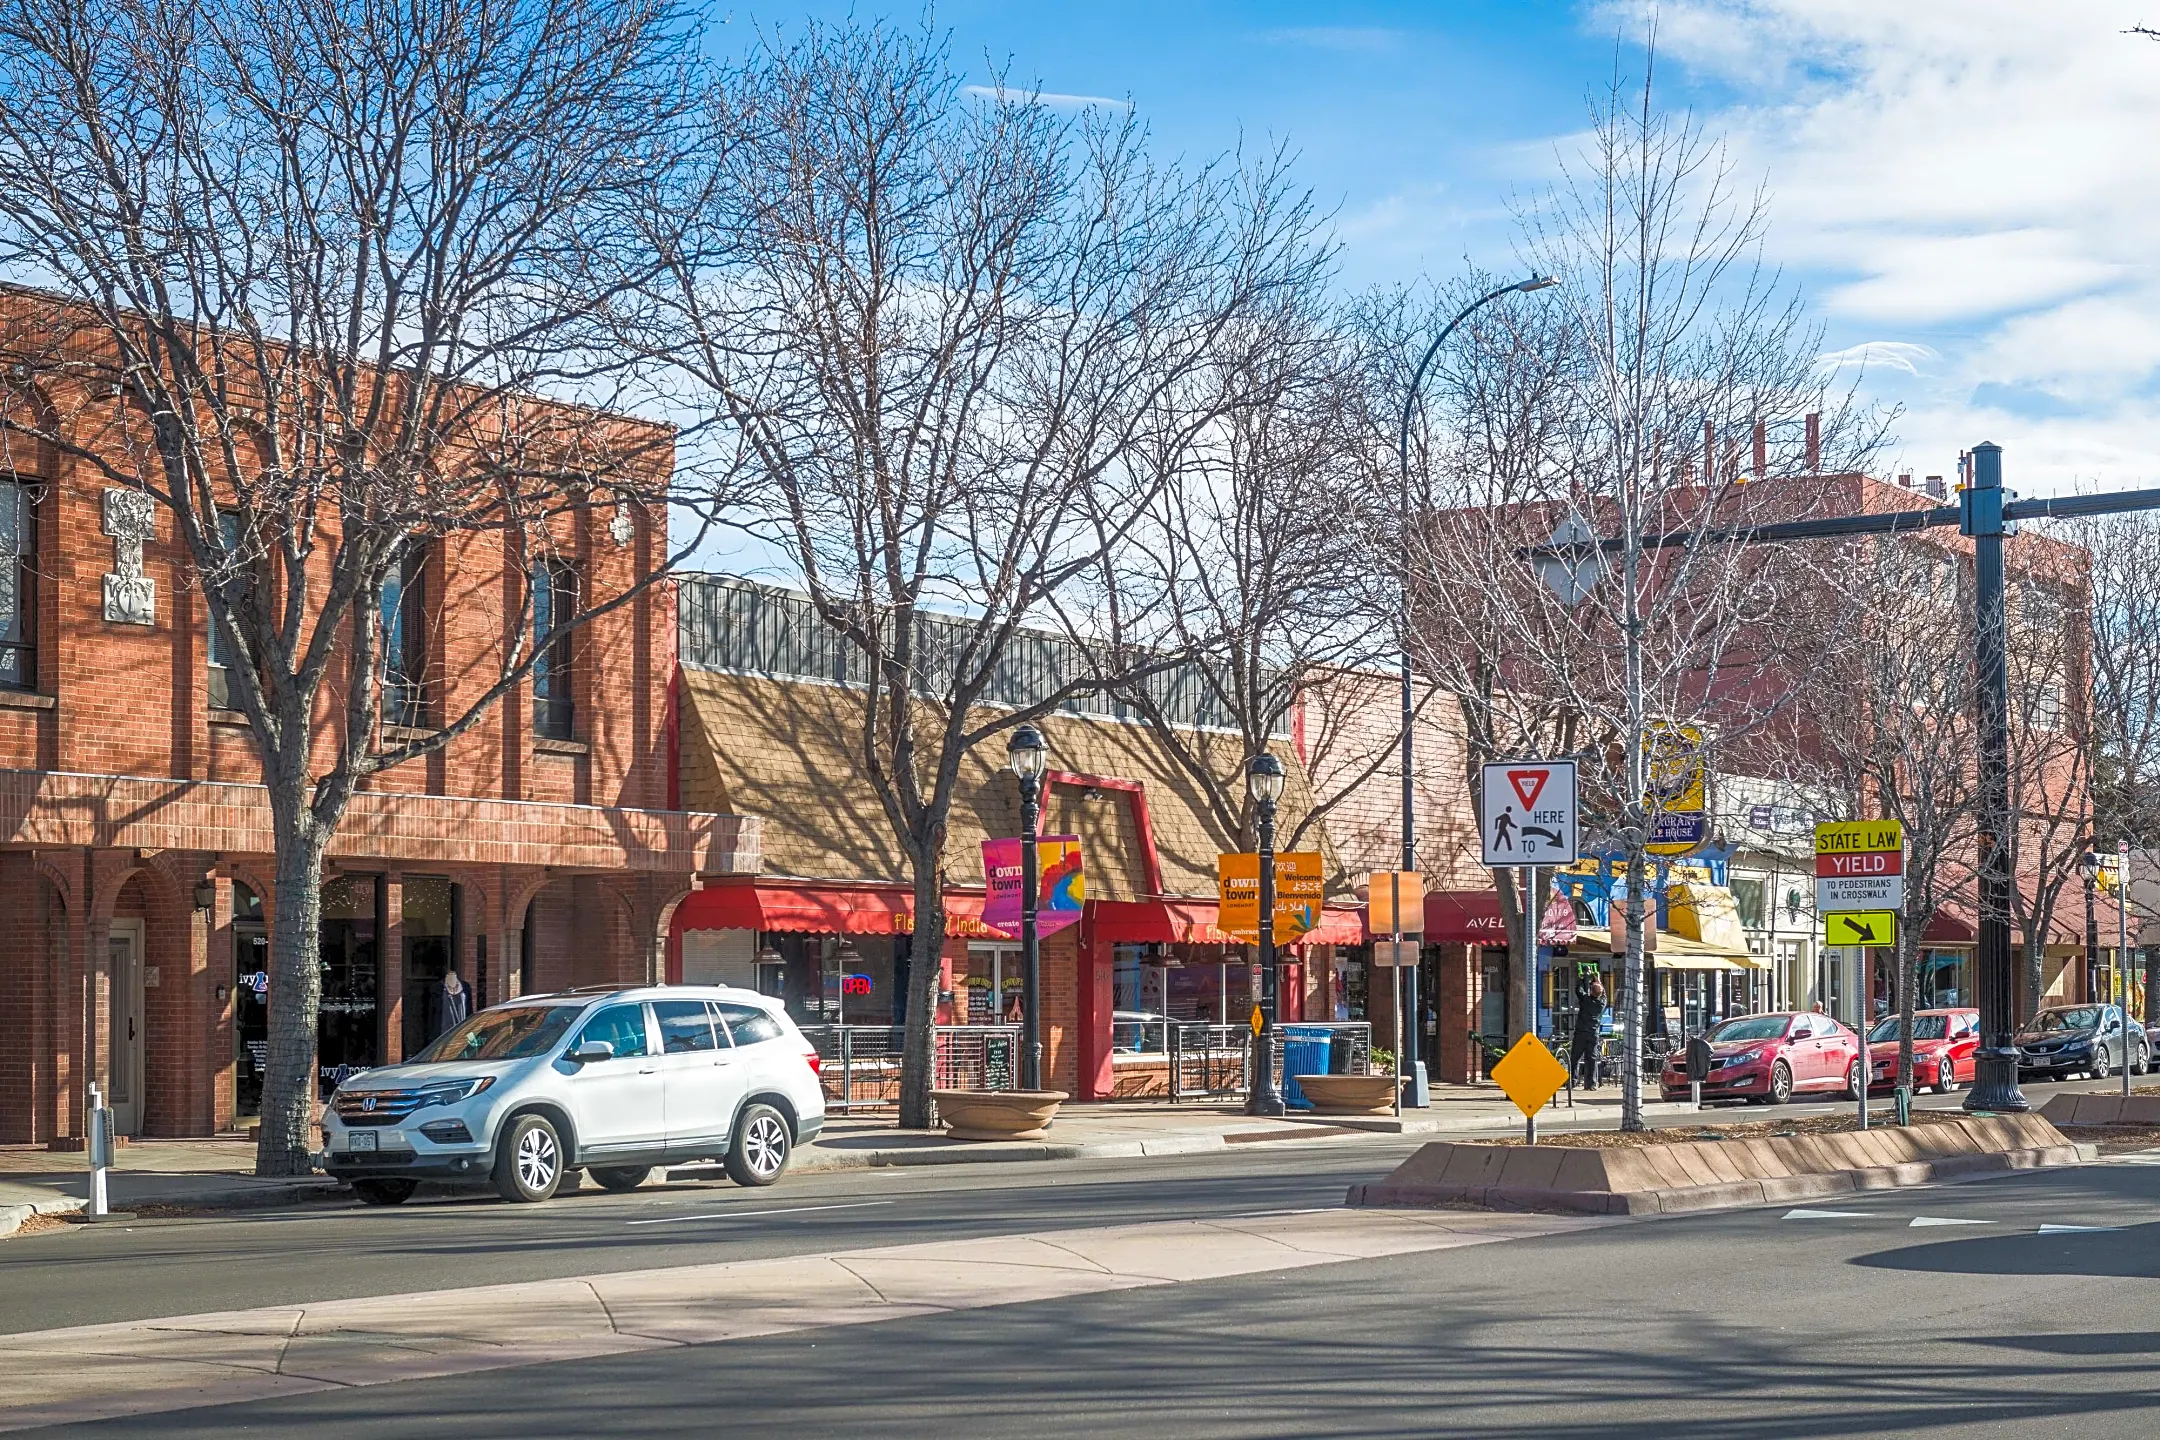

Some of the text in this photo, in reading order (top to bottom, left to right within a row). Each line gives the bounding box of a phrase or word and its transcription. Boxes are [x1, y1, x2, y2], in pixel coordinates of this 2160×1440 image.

[1534, 810, 1565, 824] HERE
[1652, 815, 1697, 827] TAURANT
[1665, 827, 1693, 837] HOUSE
[1521, 840, 1535, 853] TO
[1820, 832, 1897, 849] STATE LAW
[1276, 862, 1297, 872] 欢迎
[1832, 855, 1885, 873] YIELD
[1223, 876, 1259, 888] down
[1293, 882, 1321, 891] ようこそ
[1827, 879, 1891, 889] TO PEDESTRIANS
[1225, 888, 1258, 900] town.
[1277, 891, 1321, 899] Bienvenido
[1830, 889, 1888, 899] IN CROSSWALK
[894, 913, 914, 933] Fla
[957, 915, 988, 934] India
[239, 973, 255, 986] ivy
[843, 978, 871, 994] OPEN
[320, 1066, 338, 1079] ivy
